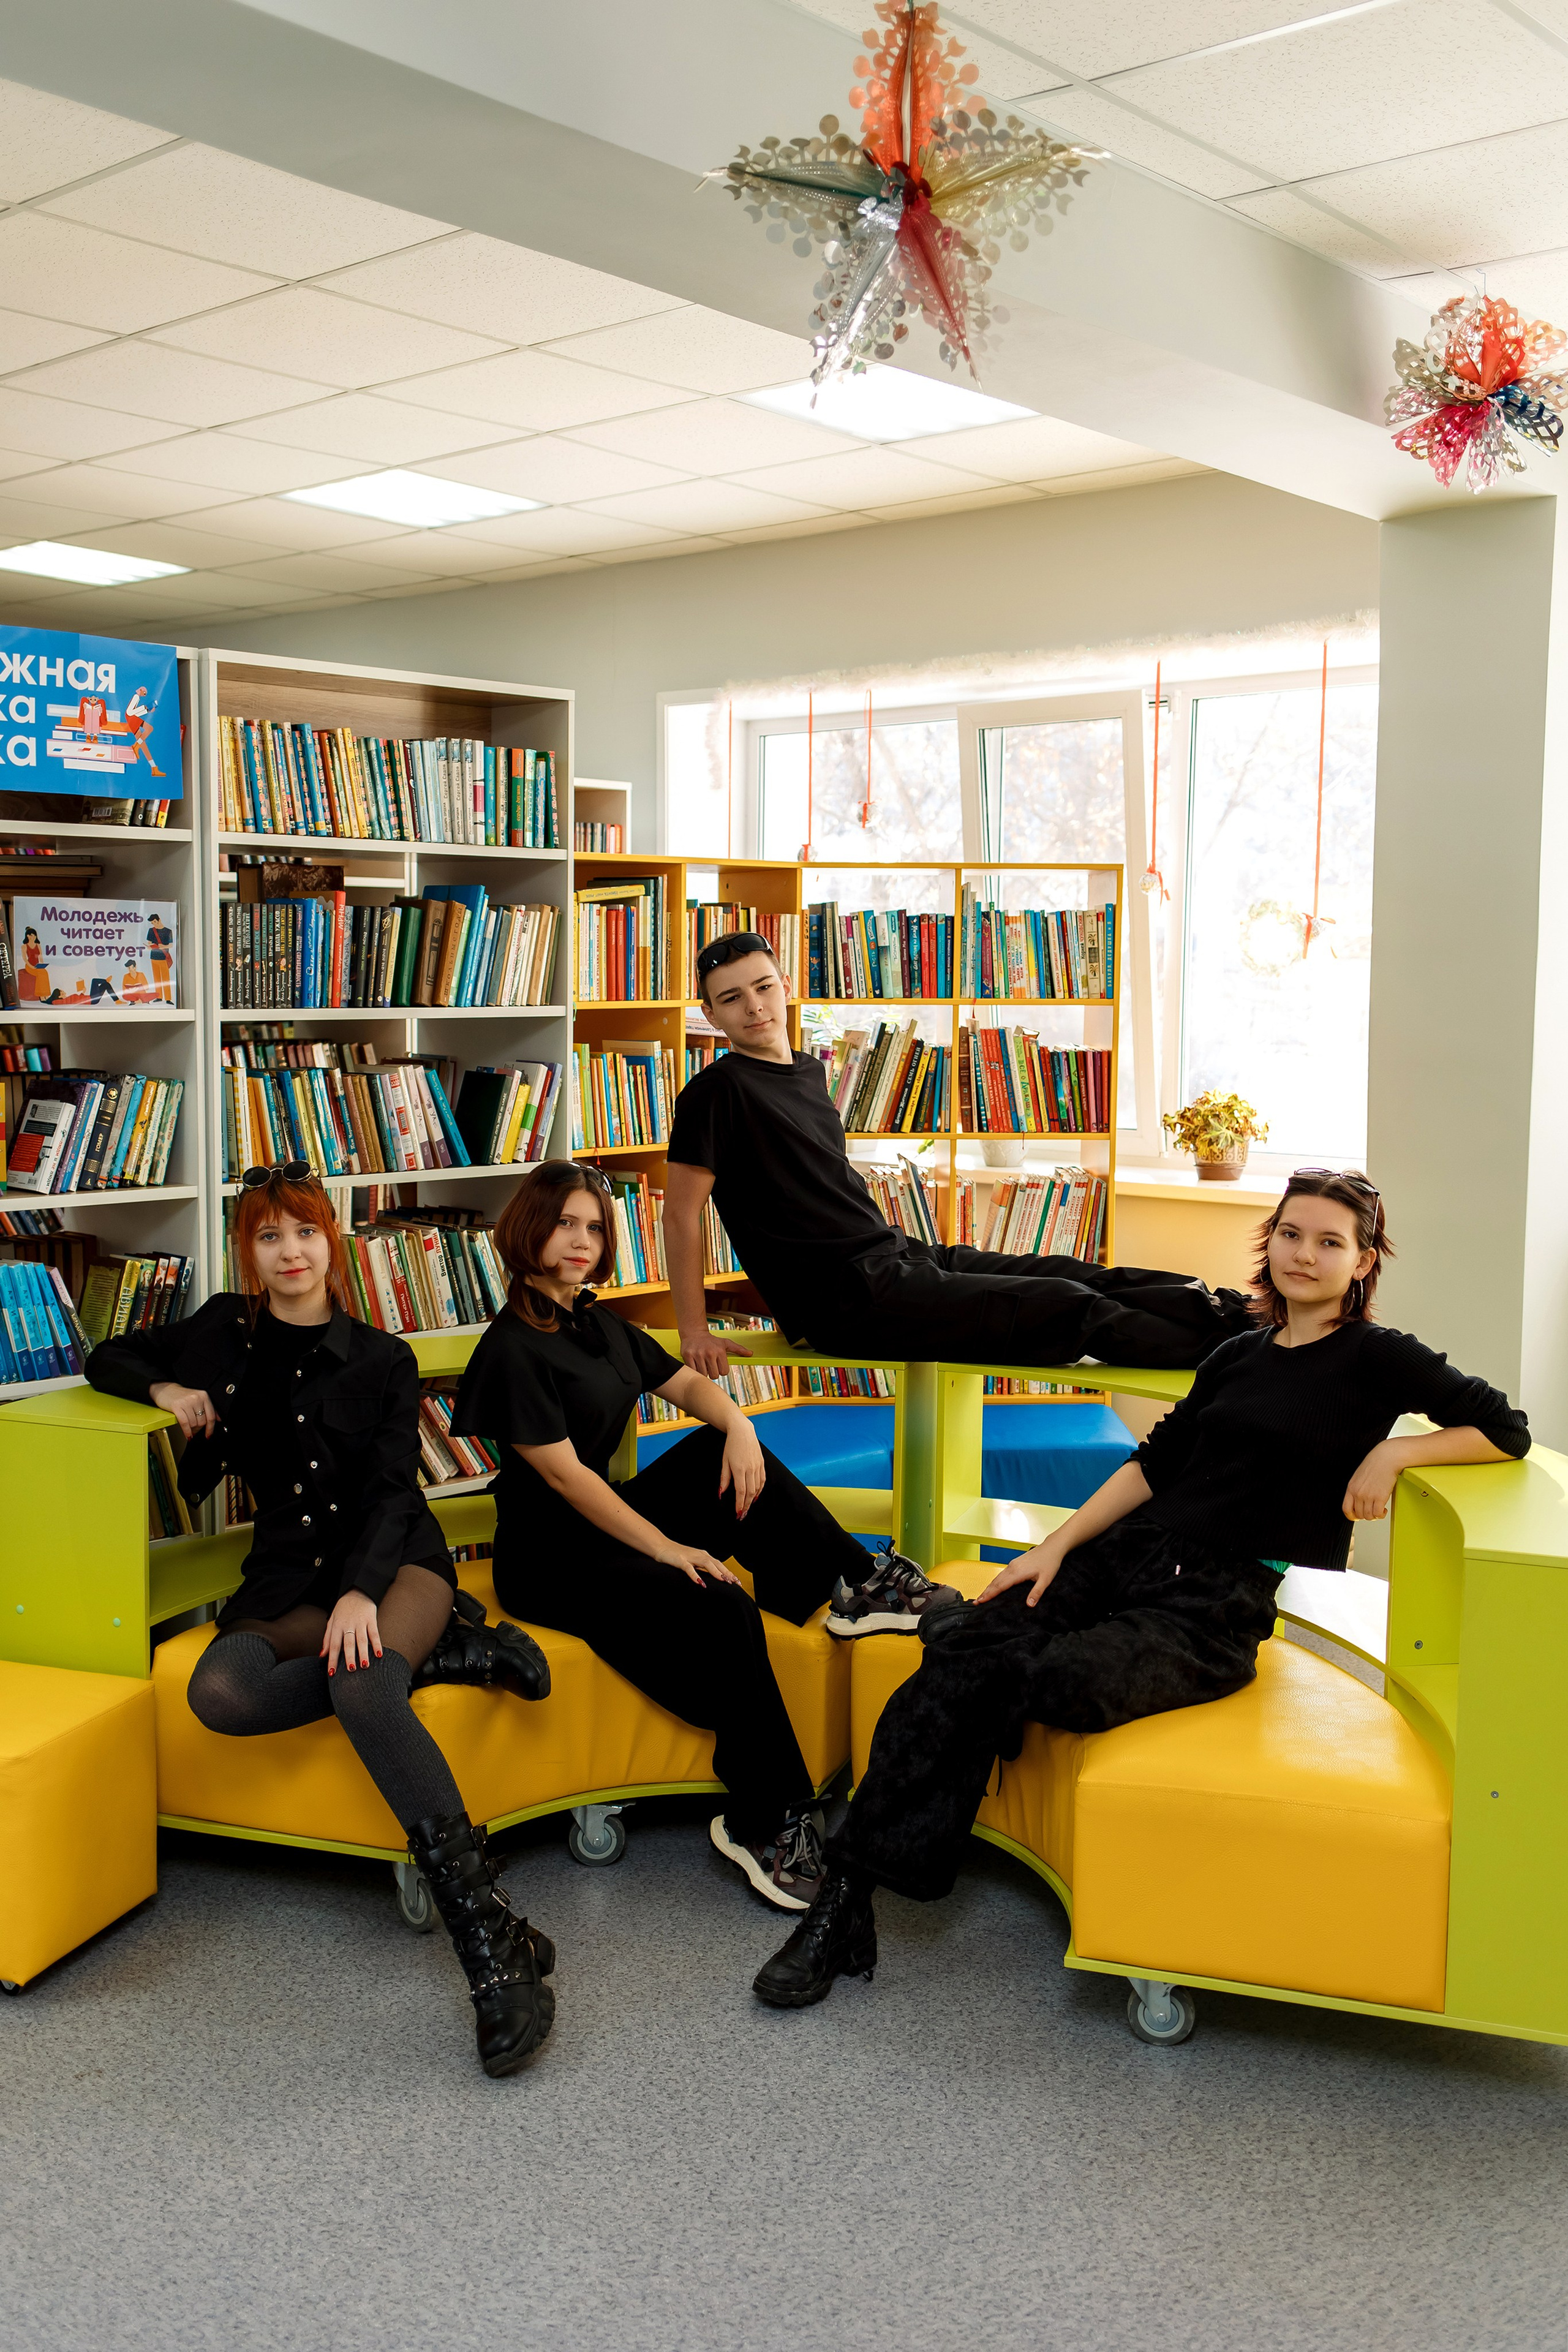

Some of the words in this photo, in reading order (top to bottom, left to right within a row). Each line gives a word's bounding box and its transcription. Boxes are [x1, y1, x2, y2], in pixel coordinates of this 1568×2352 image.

[40, 906, 144, 925] Молодежь
[61, 927, 125, 940] читает
[45, 944, 56, 956] и
[62, 944, 146, 961] советует
[443, 936, 458, 997] ШКОЛЬНЫЕ
[453, 907, 462, 935] ГОДЫ
[905, 1067, 915, 1084] СЕМЬ
[910, 1046, 921, 1067] ОГНЕЙ
[867, 1061, 881, 1096] СОЛНЕЧНЫЙ
[894, 1107, 903, 1124] Борис
[899, 1087, 909, 1107] Житков
[94, 1133, 104, 1152] ГОМЕР
[431, 1232, 442, 1254] ЛУНИН
[436, 1254, 447, 1276] Виктор
[162, 1295, 171, 1314] ВОДЫ
[70, 1313, 86, 1341] КОРАЛИНА
